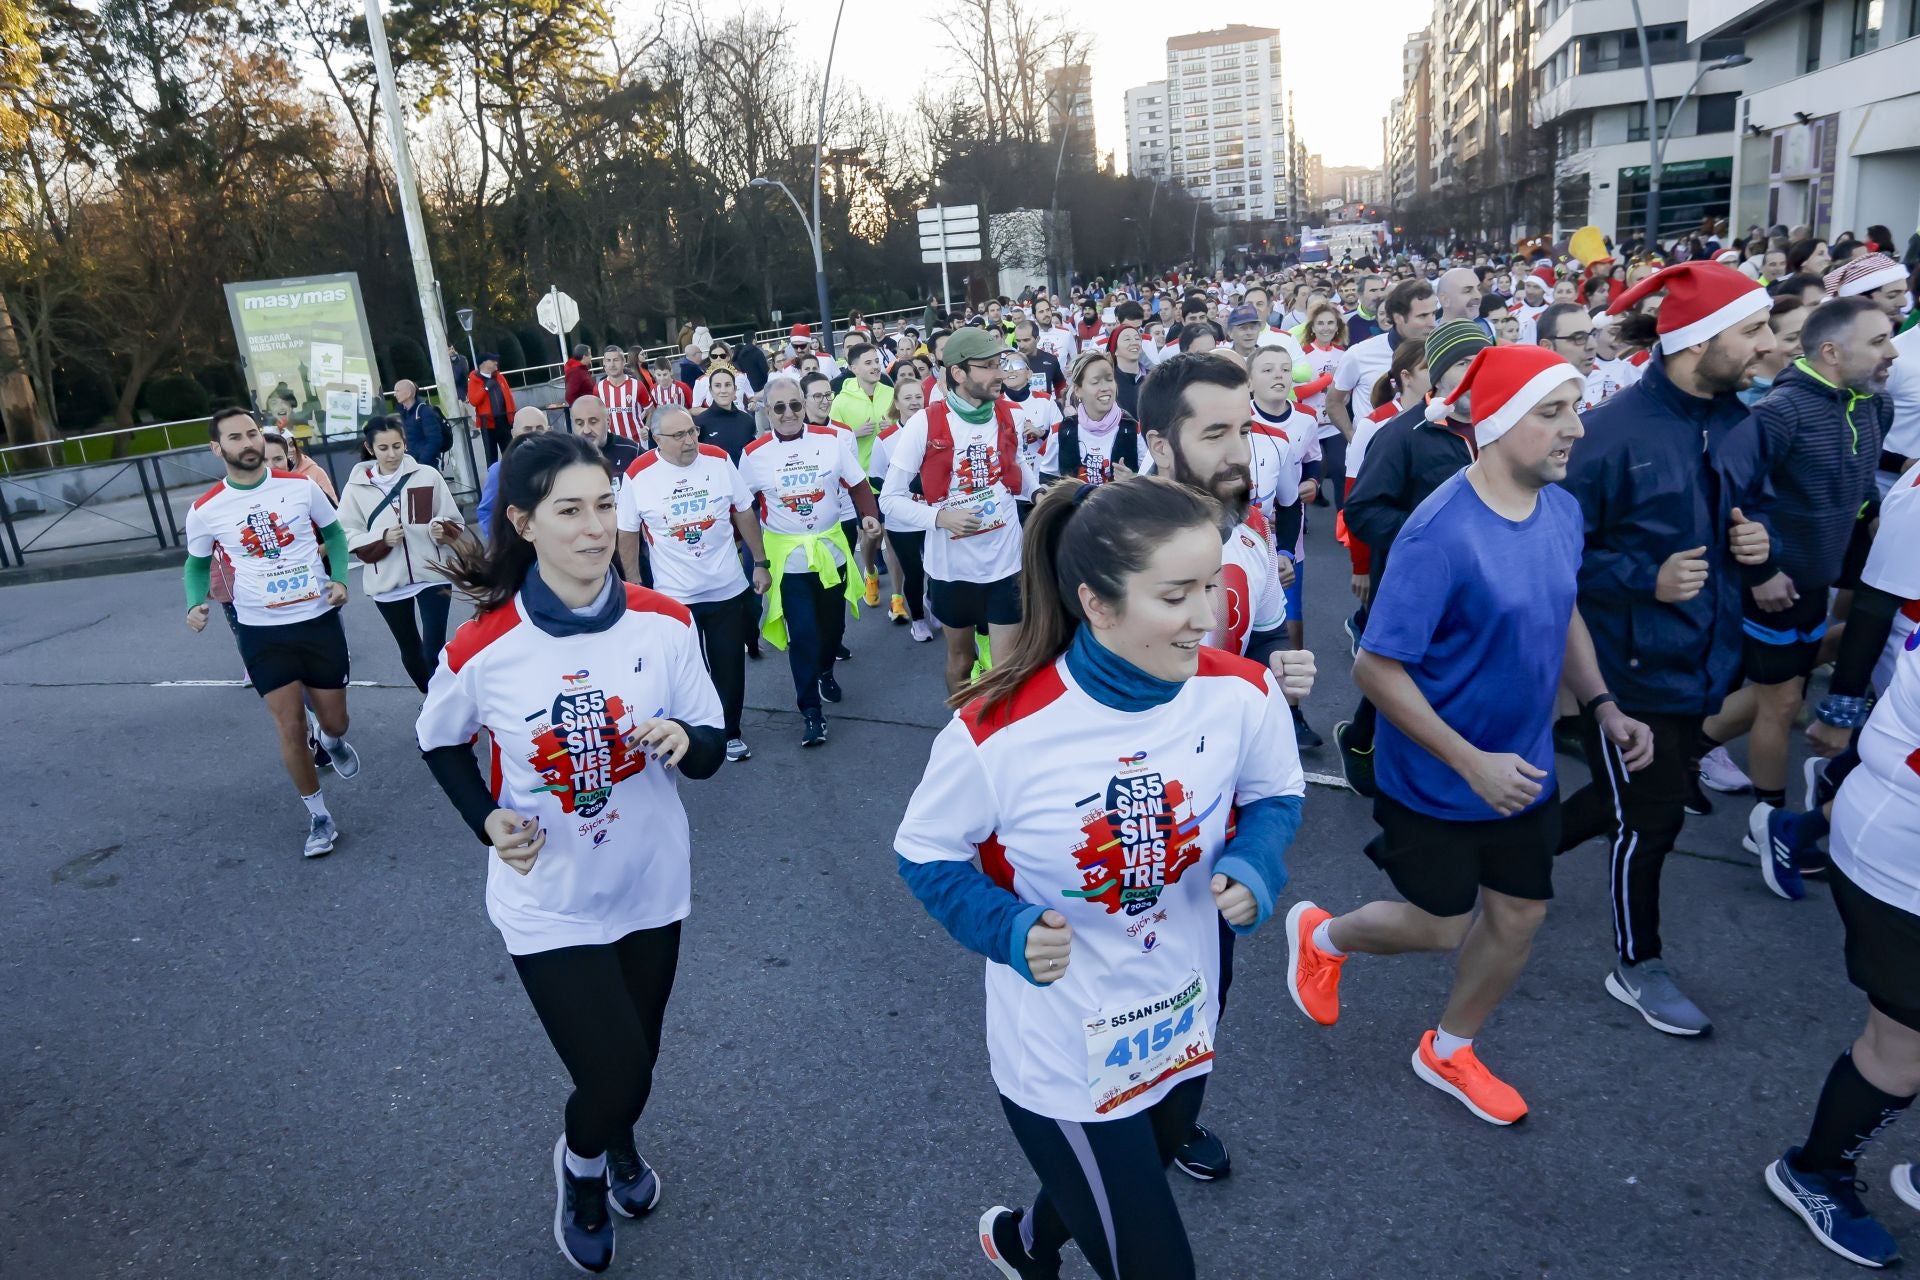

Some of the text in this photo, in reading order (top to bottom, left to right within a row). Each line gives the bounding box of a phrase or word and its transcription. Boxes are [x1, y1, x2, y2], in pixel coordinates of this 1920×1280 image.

[244, 288, 346, 309] masymas
[249, 333, 291, 345] DESCARGA
[250, 339, 304, 352] NUESTRA APP
[970, 451, 987, 460] SAN
[976, 444, 987, 452] 55
[971, 460, 987, 470] SIL
[1086, 460, 1102, 469] SAN
[1086, 468, 1101, 476] SIL
[781, 472, 817, 487] 3707
[971, 469, 989, 478] VES
[971, 478, 989, 487] TRE
[671, 498, 707, 515] 3757
[251, 518, 271, 528] SAN
[256, 511, 269, 520] 55
[254, 526, 274, 535] SIL
[258, 532, 277, 543] VES
[260, 542, 280, 551] TRE
[266, 574, 309, 593] 4937
[575, 692, 604, 714] 55
[561, 711, 607, 732] SAN
[566, 729, 608, 754] SIL
[570, 747, 611, 773] VES
[570, 765, 612, 791] TRE
[1131, 775, 1164, 800] 55
[578, 788, 607, 803] GIJÓN
[1116, 795, 1164, 819] SAN
[1120, 816, 1164, 845] SIL
[1121, 839, 1166, 868] VES
[1120, 862, 1165, 888] TRE
[1125, 887, 1158, 900] GIJÓN
[1111, 1014, 1127, 1028] 55
[1128, 1005, 1153, 1023] SAN
[1154, 977, 1200, 1013] SILVESTRE
[1104, 1005, 1195, 1067] 4154
